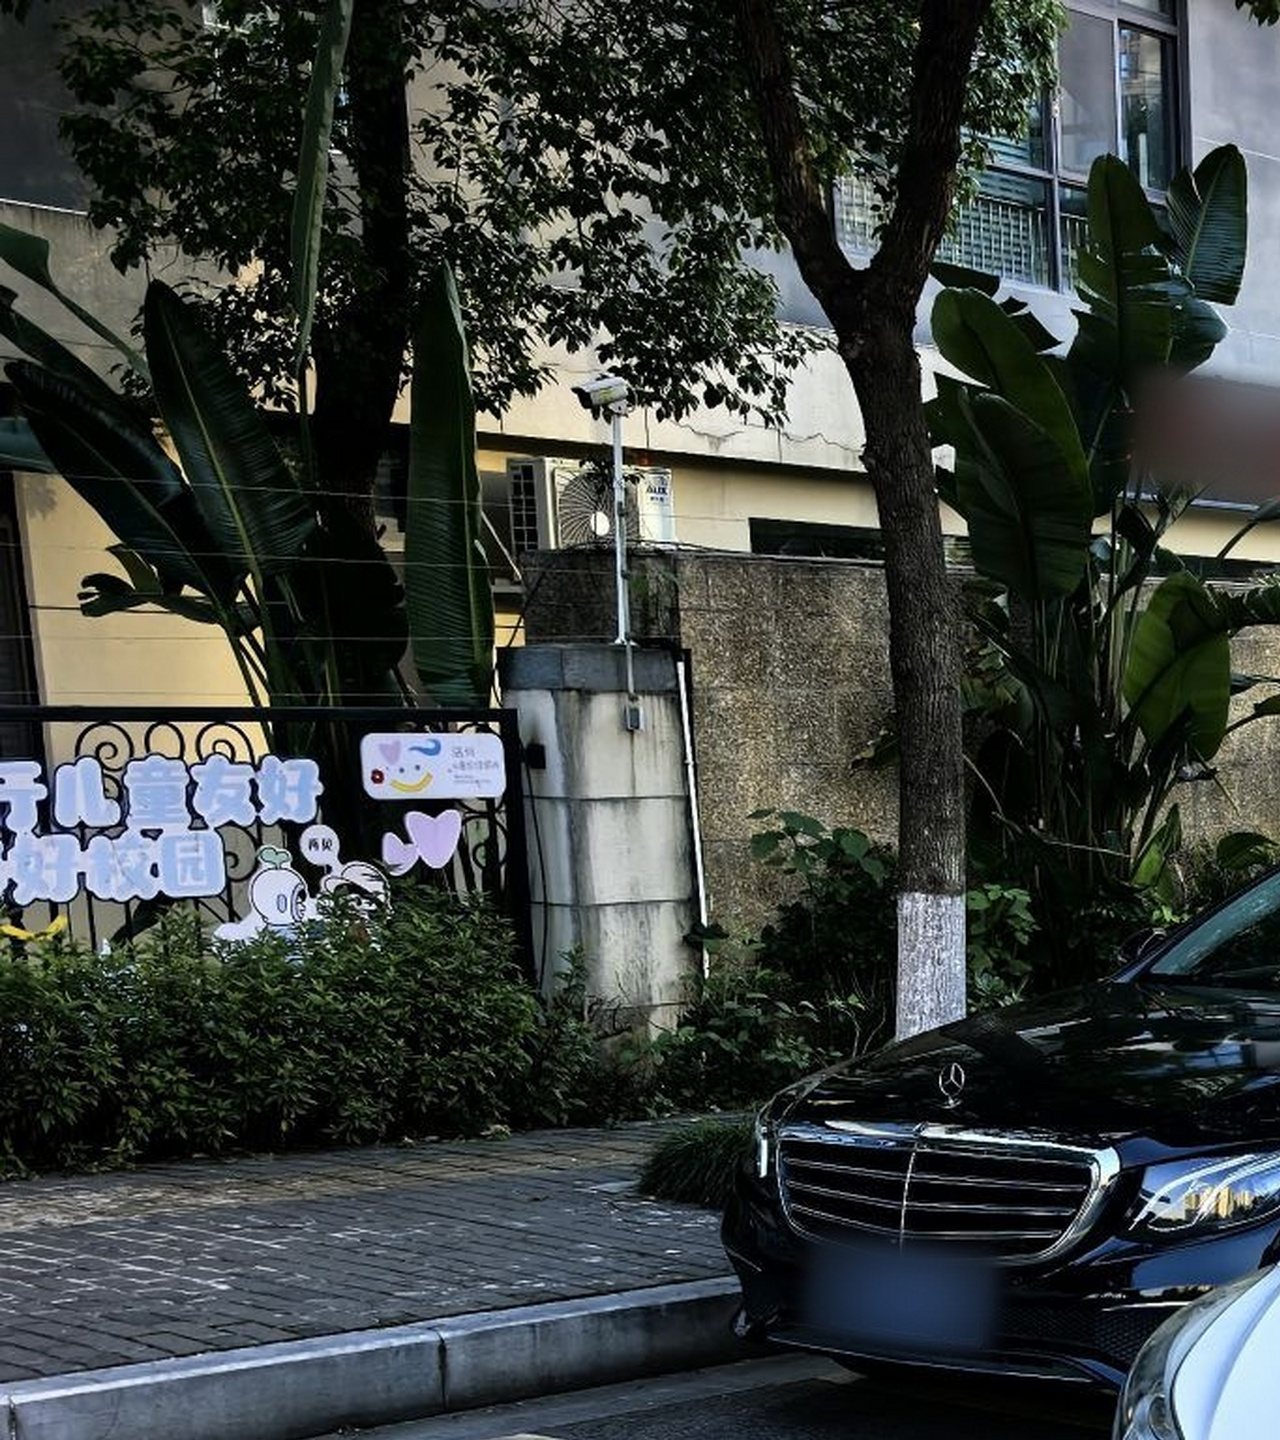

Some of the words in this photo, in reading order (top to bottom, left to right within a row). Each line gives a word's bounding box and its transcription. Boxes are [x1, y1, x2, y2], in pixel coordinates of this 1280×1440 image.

[0, 828, 226, 905] 好校园
[308, 838, 333, 851] 再见
